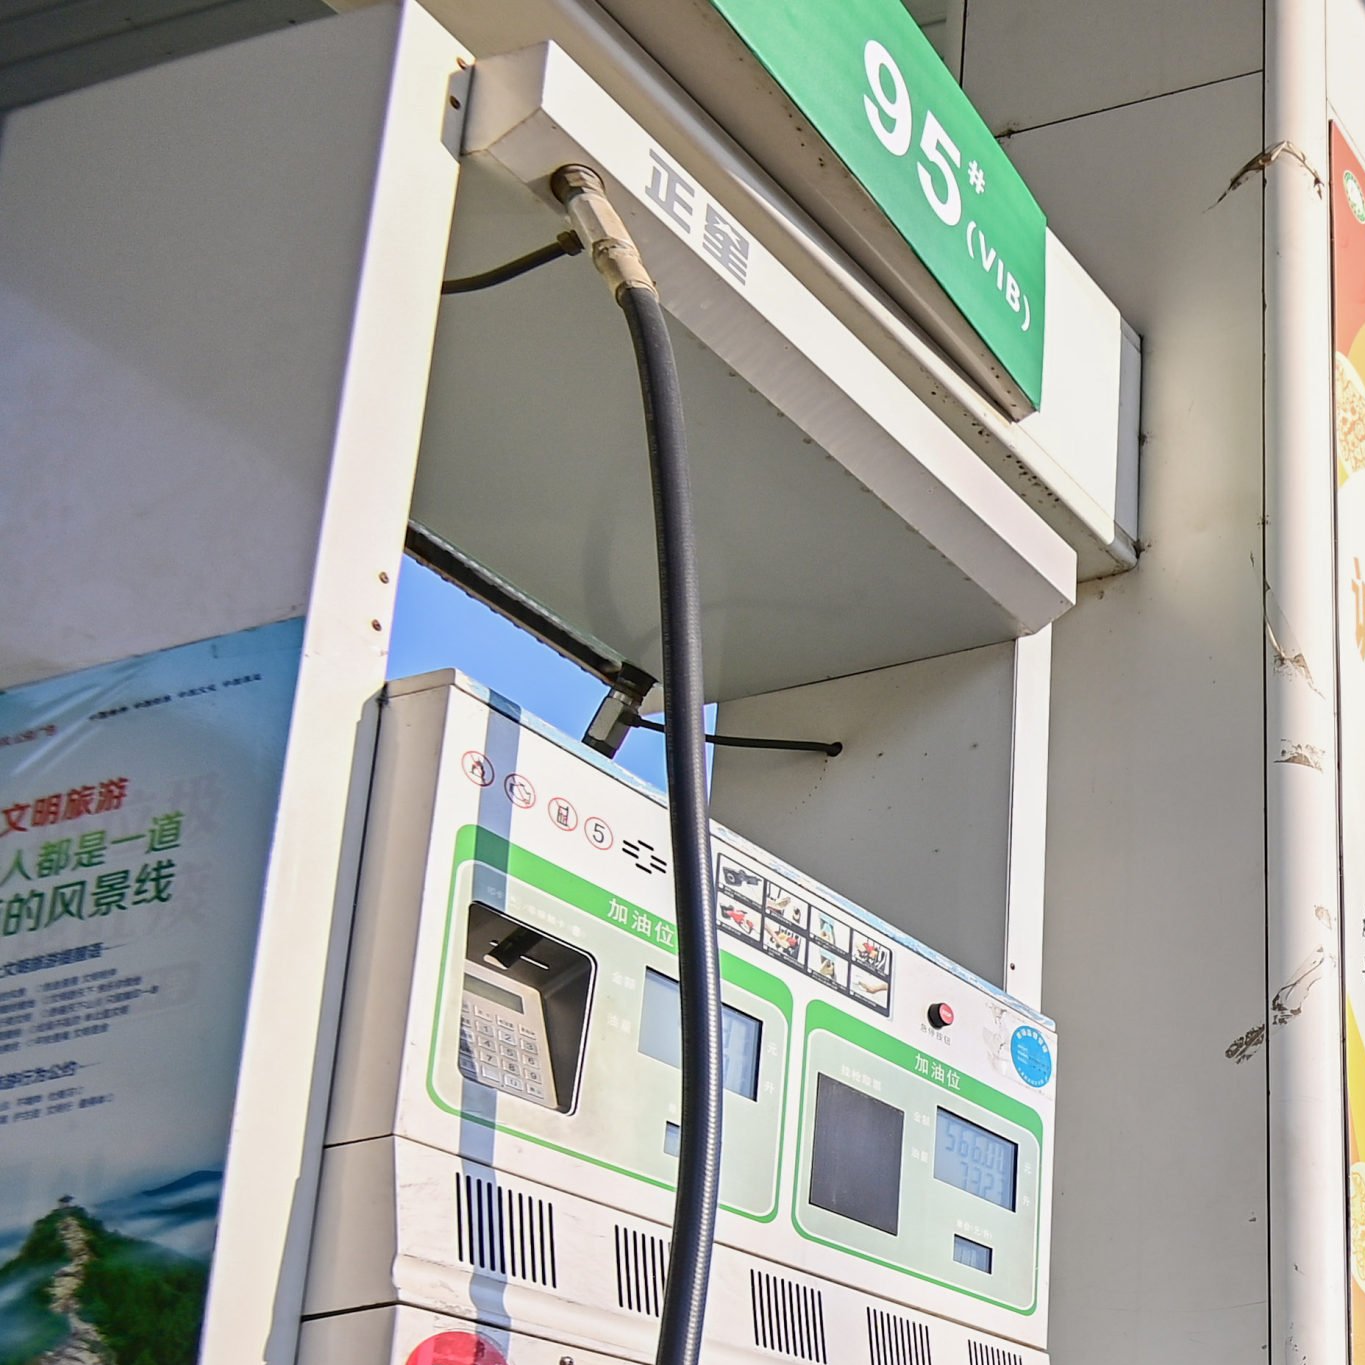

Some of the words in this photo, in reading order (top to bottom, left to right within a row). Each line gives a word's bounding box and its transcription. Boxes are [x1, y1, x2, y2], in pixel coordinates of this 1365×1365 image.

[645, 148, 749, 286] 正星
[966, 220, 1031, 332] (VIB)
[0, 777, 130, 838] 文明旅游
[592, 822, 605, 843] 5
[0, 810, 186, 888] 人都是一道
[607, 898, 675, 948] 加油位
[914, 1053, 961, 1091] 加油位
